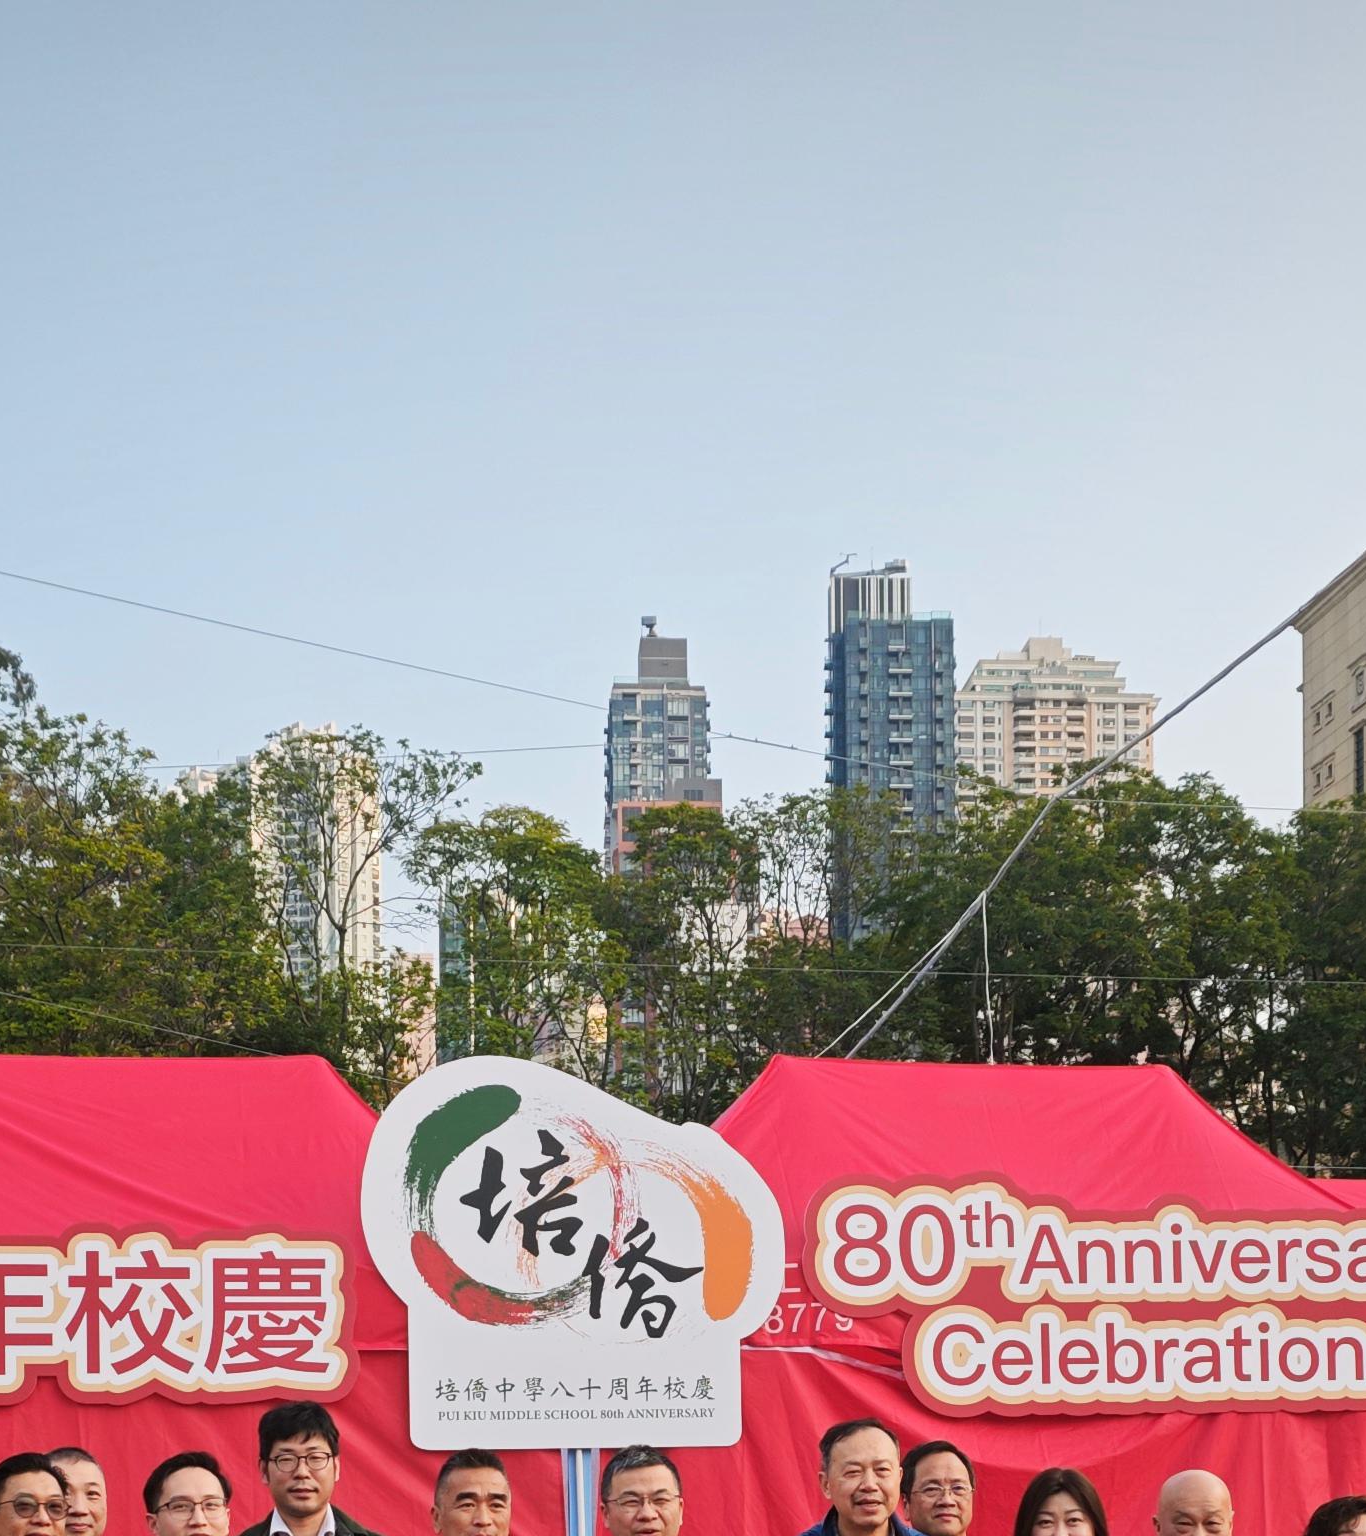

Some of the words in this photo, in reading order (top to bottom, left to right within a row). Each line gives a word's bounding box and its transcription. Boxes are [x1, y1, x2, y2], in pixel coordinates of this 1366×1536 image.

[459, 1129, 704, 1339] 培僑
[833, 1200, 1015, 1287] 80th
[932, 1321, 1366, 1387] Celebration
[434, 1374, 716, 1403] 培僑中學八十周年校慶
[437, 1410, 461, 1421] PUI
[463, 1410, 487, 1421] KIU
[489, 1409, 542, 1421] MIDDLE
[544, 1408, 598, 1420] SCHOOL
[600, 1408, 625, 1419] 80th
[626, 1407, 716, 1419] ANNIVERSARY
